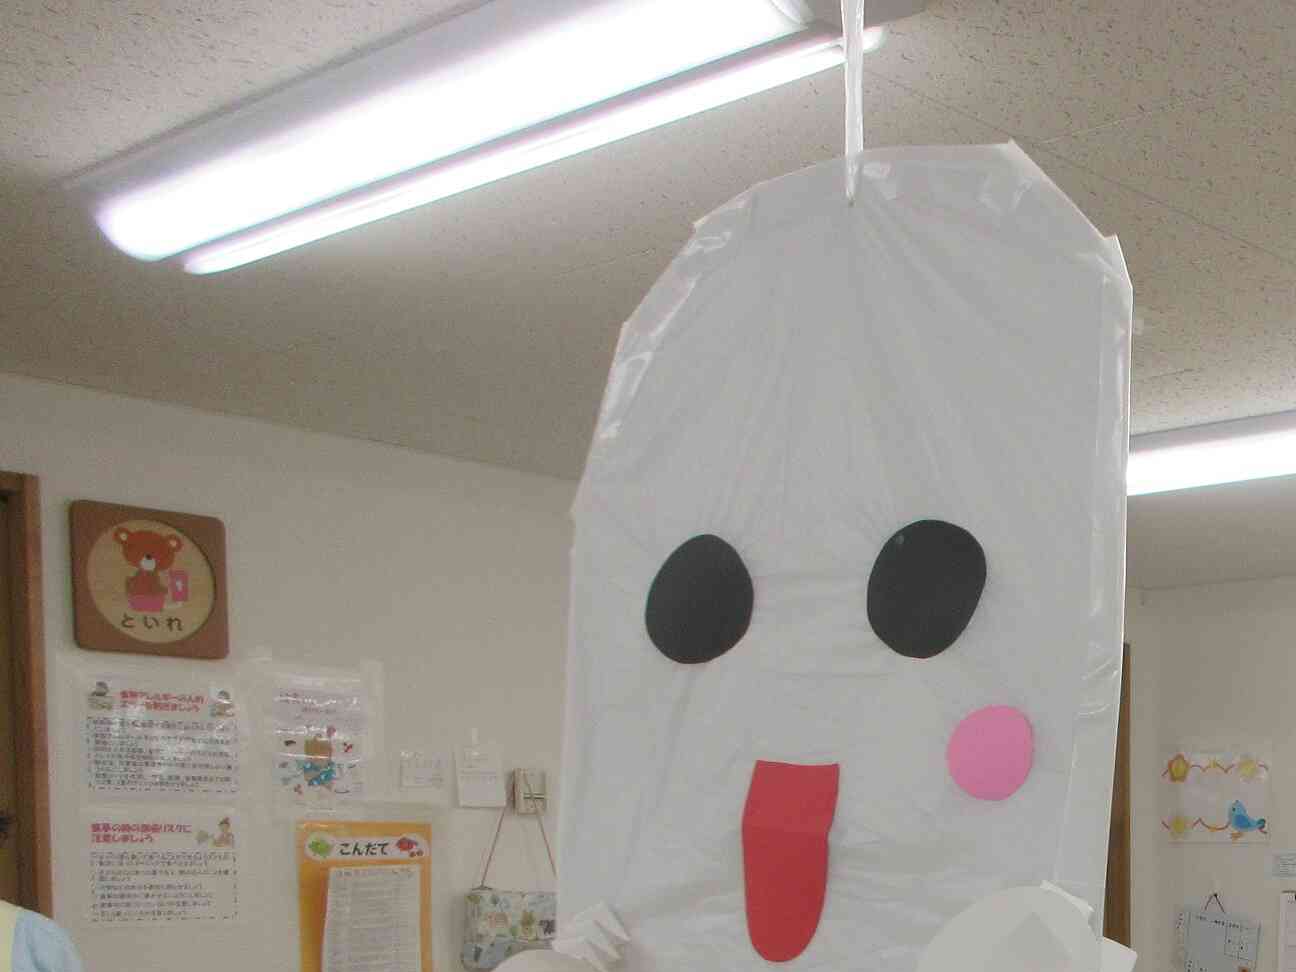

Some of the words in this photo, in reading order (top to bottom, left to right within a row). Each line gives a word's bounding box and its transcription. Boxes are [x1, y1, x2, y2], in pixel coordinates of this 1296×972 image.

[121, 612, 182, 632] といれ
[338, 841, 390, 856] こんだて
